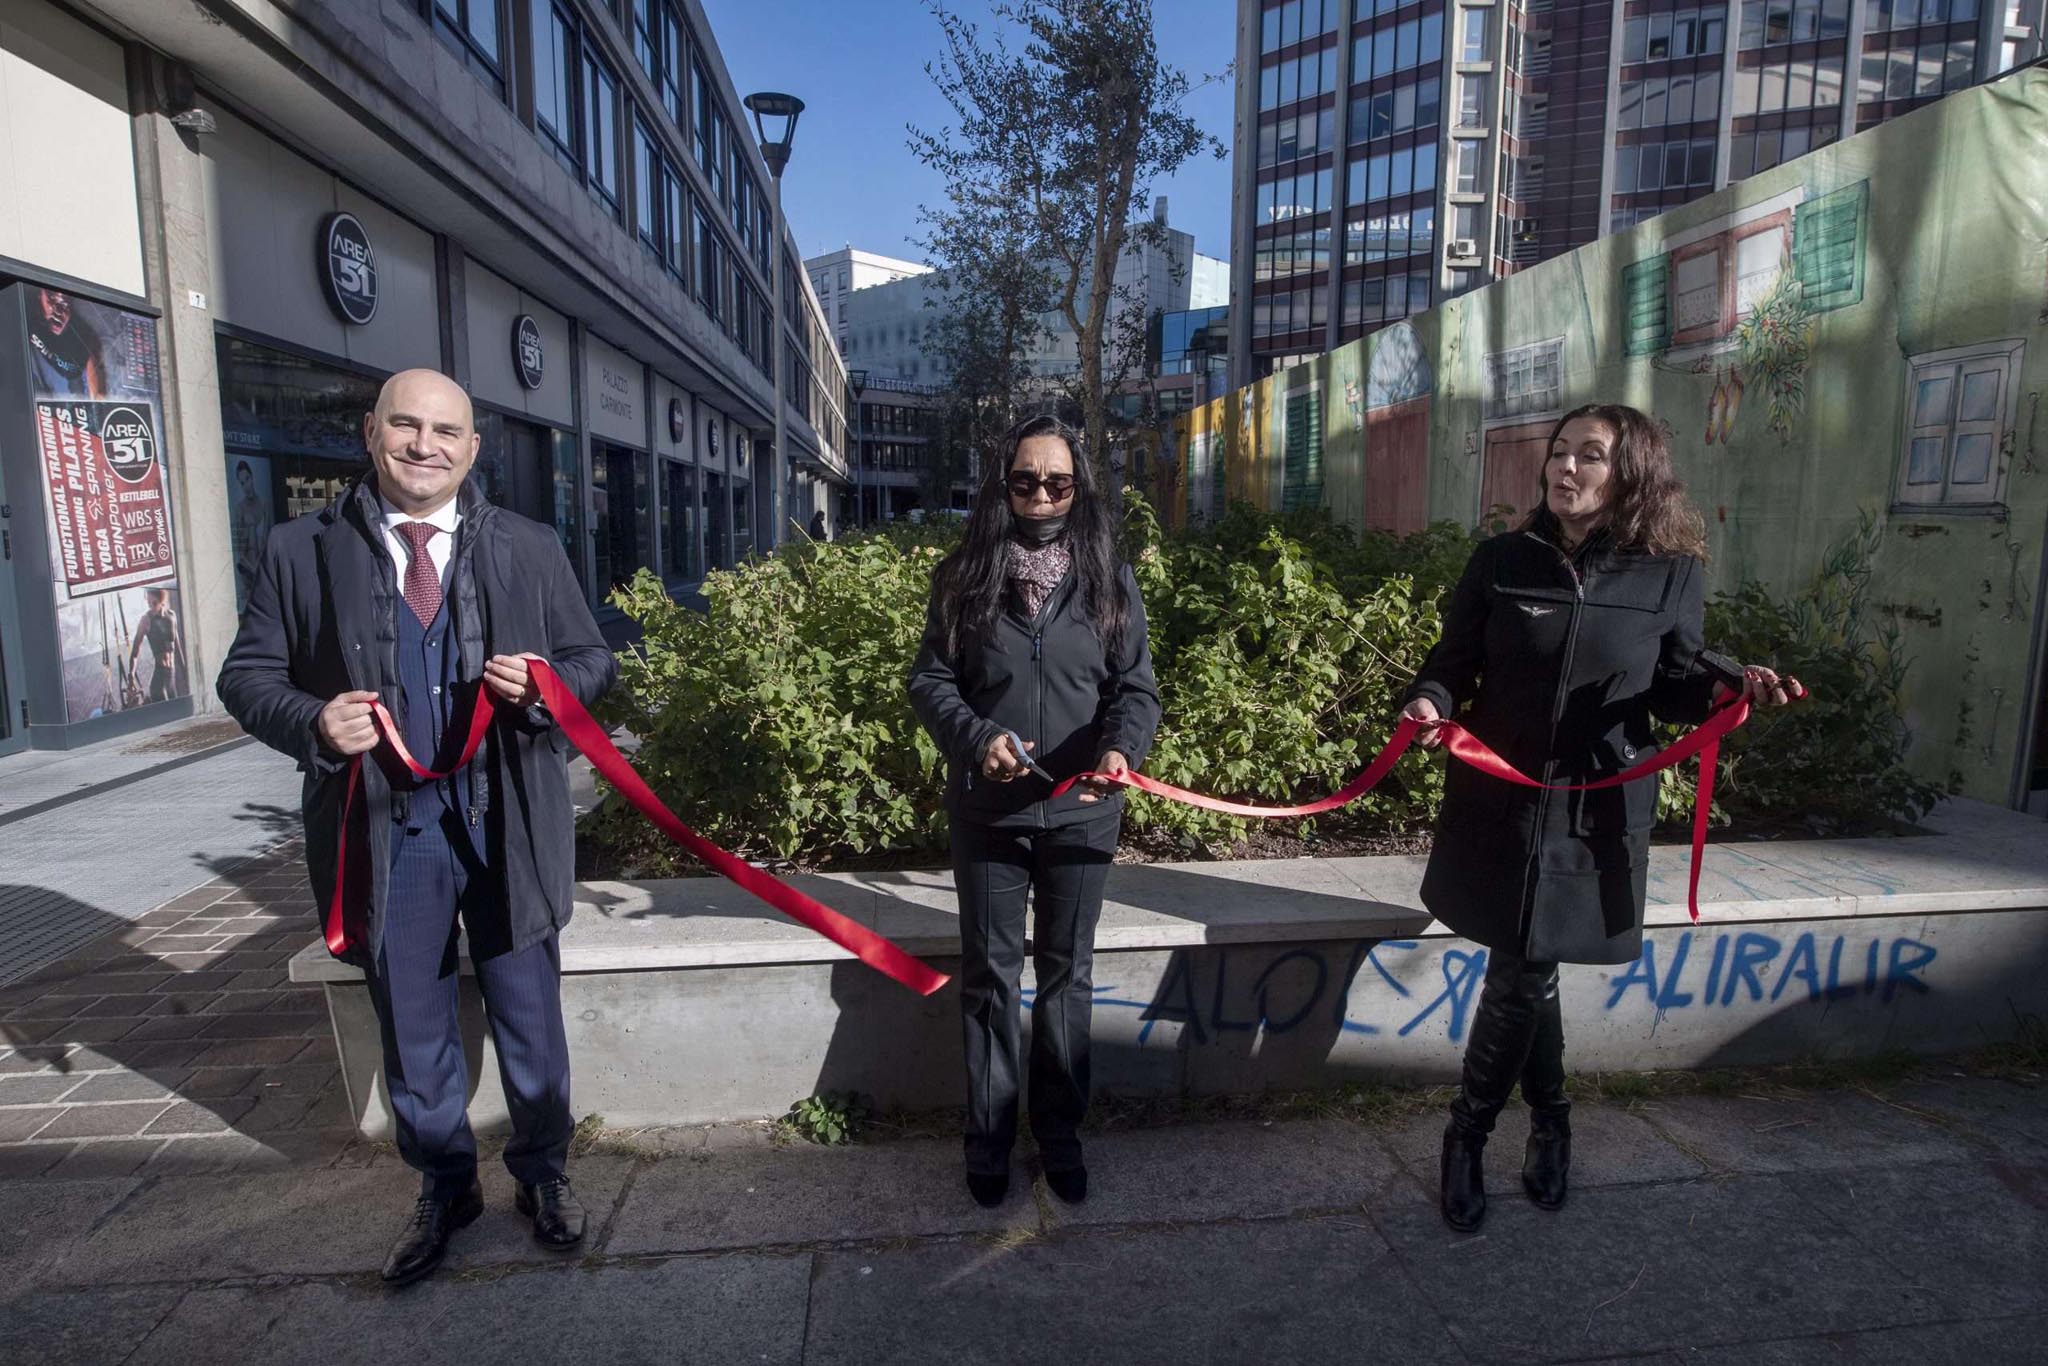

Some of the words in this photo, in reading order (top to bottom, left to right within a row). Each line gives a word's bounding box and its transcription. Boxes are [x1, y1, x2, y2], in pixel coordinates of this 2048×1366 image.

[334, 234, 373, 267] AREA
[339, 258, 370, 296] 51
[523, 346, 541, 371] 51
[39, 405, 62, 480] TRAINING
[56, 407, 84, 492] PILATES
[106, 424, 148, 438] AREA
[75, 407, 101, 496] SPINNING
[112, 437, 147, 464] 51
[119, 489, 160, 503] KETTLEBELL
[53, 484, 80, 579] FUNCTIONAL
[73, 497, 96, 577] STRETCHING
[122, 508, 153, 529] WBS
[154, 507, 167, 544] ZUMBA
[95, 528, 114, 574] YOGA
[128, 541, 156, 560] TRX
